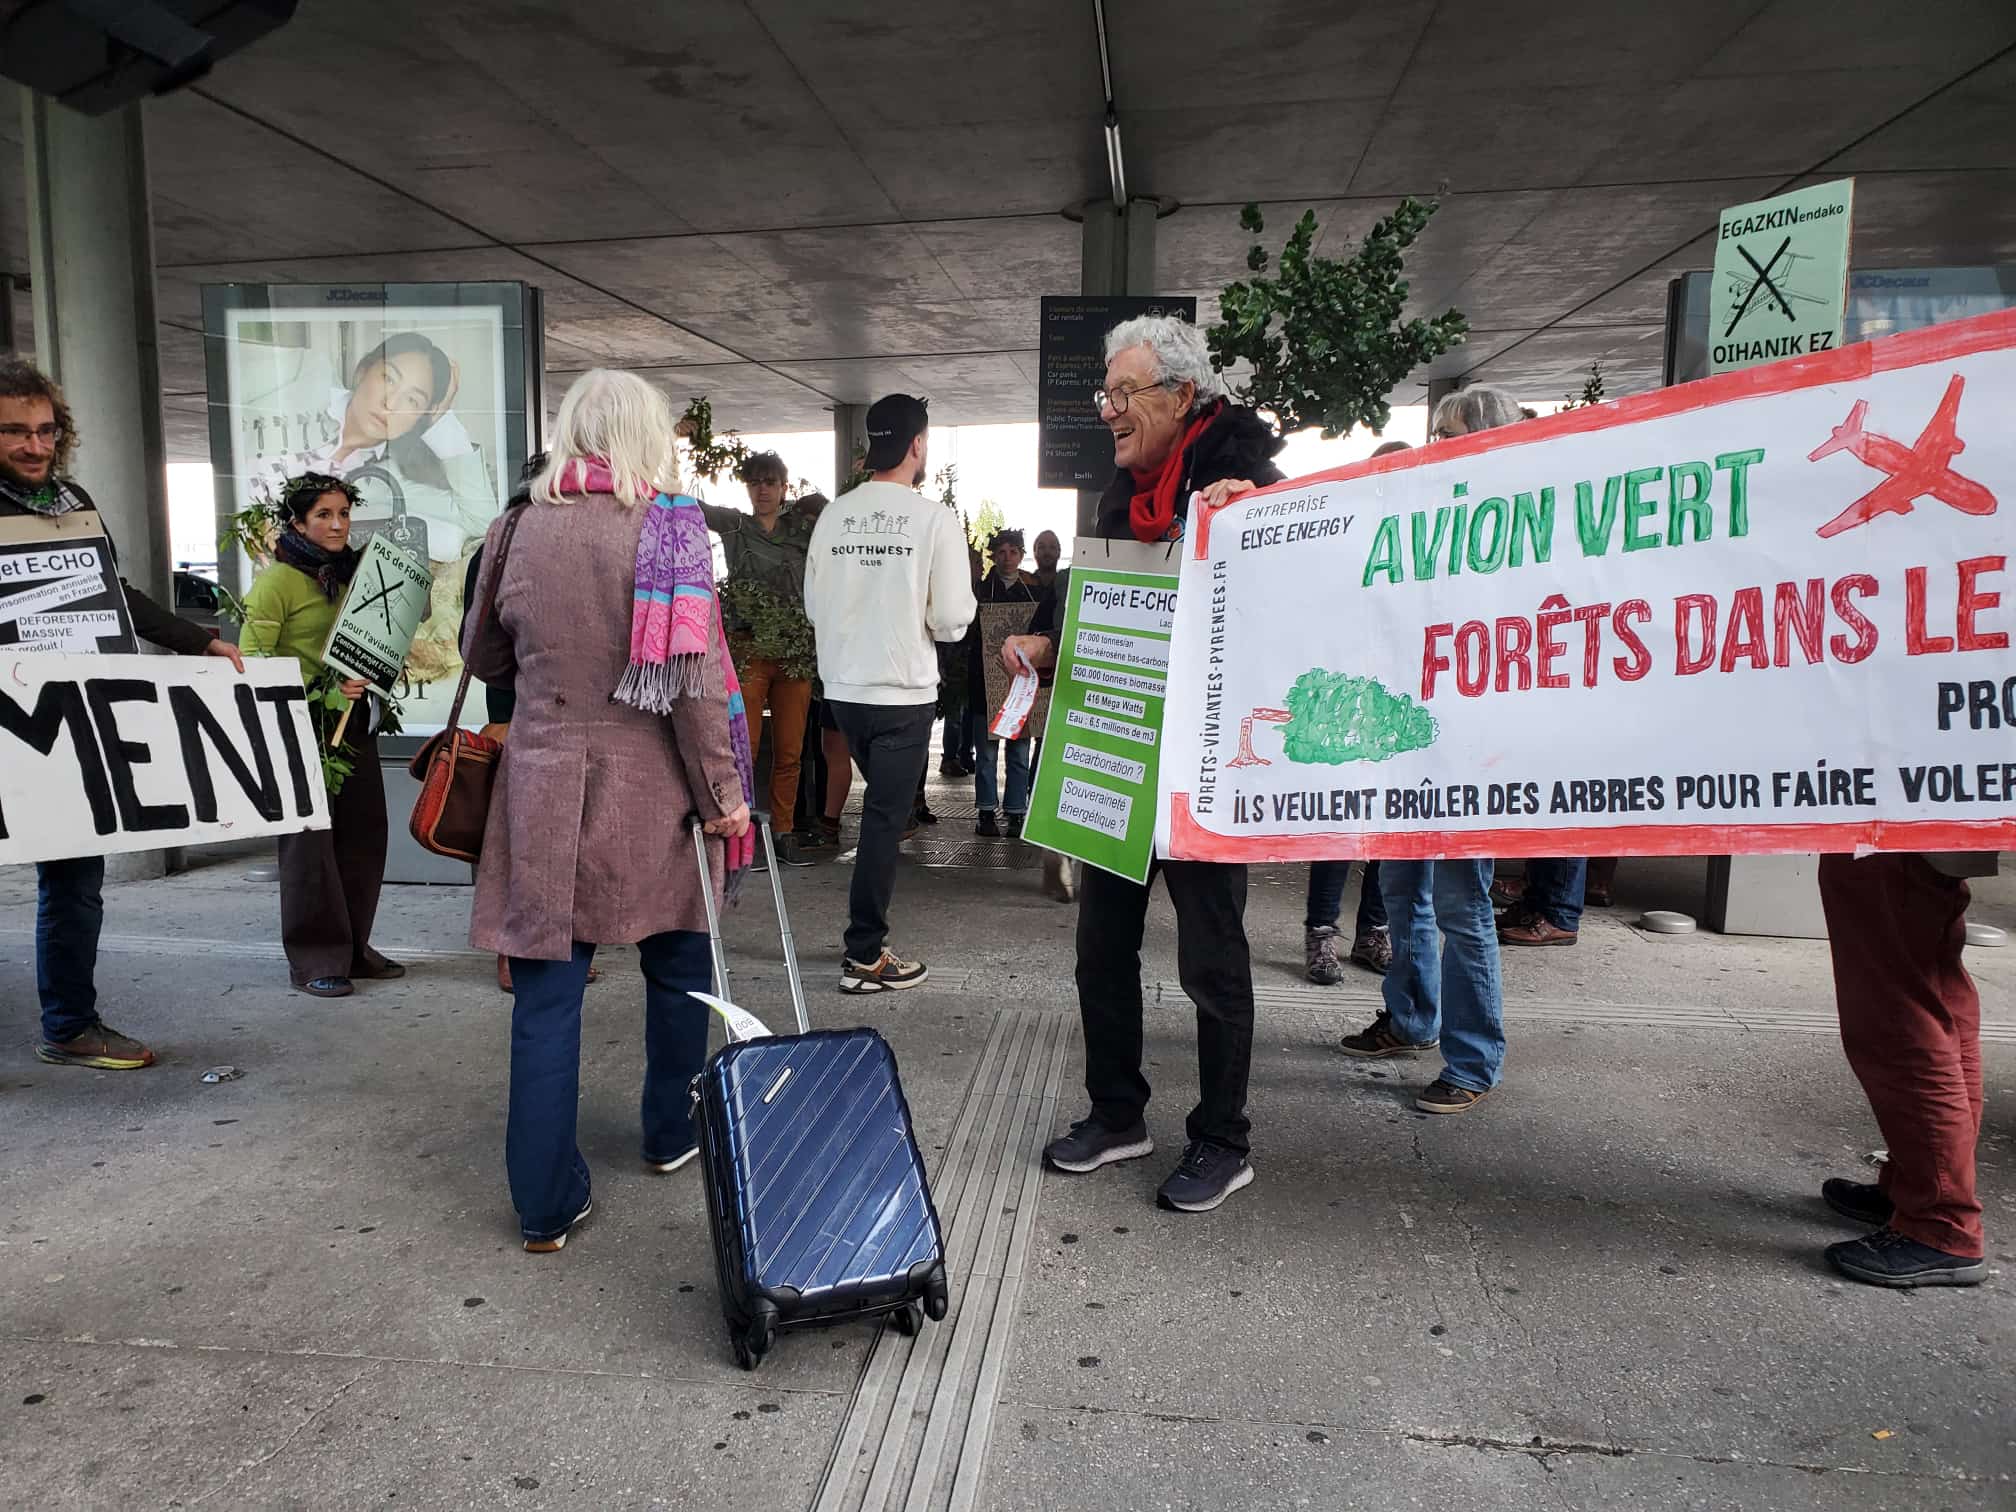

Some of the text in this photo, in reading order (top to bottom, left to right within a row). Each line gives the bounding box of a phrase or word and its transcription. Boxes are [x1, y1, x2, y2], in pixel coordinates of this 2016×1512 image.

[1713, 331, 1834, 363] OIHANIK EZ
[1067, 416, 1098, 424] Transport
[1574, 448, 1766, 557] VERT
[1241, 514, 1354, 551] ELYSE ENERGY
[25, 552, 95, 574] E-CHO
[373, 542, 392, 561] PAS
[392, 555, 404, 570] de
[831, 545, 914, 557] SOUTHWEST
[860, 559, 882, 567] CLUB
[59, 583, 105, 602] en France
[1083, 585, 1126, 610] Projet
[20, 612, 116, 626] DEFORESTATION
[1421, 555, 2010, 701] FORÊTS DANS LE
[21, 628, 73, 640] MASSIVE
[341, 619, 363, 637] pour
[364, 630, 400, 662] l'aviation
[1102, 672, 1127, 685] tonnes
[1129, 678, 1166, 693] biomasse
[1122, 700, 1144, 714] Watts
[1069, 712, 1084, 725] Eau
[1089, 716, 1101, 729] 6,5
[1101, 721, 1130, 737] millions
[1131, 727, 1141, 739] de
[1143, 731, 1155, 742] m3
[1065, 746, 1143, 779] Décarbonation ?
[1064, 781, 1126, 812] Souveraineté
[1272, 788, 1378, 822] VEULENT
[1384, 777, 1480, 820] BRÛLER
[1487, 782, 1540, 815] DES
[1550, 775, 1664, 814] ARBRES
[1676, 773, 1760, 810] POUR
[1060, 801, 1126, 833] énergétique ?
